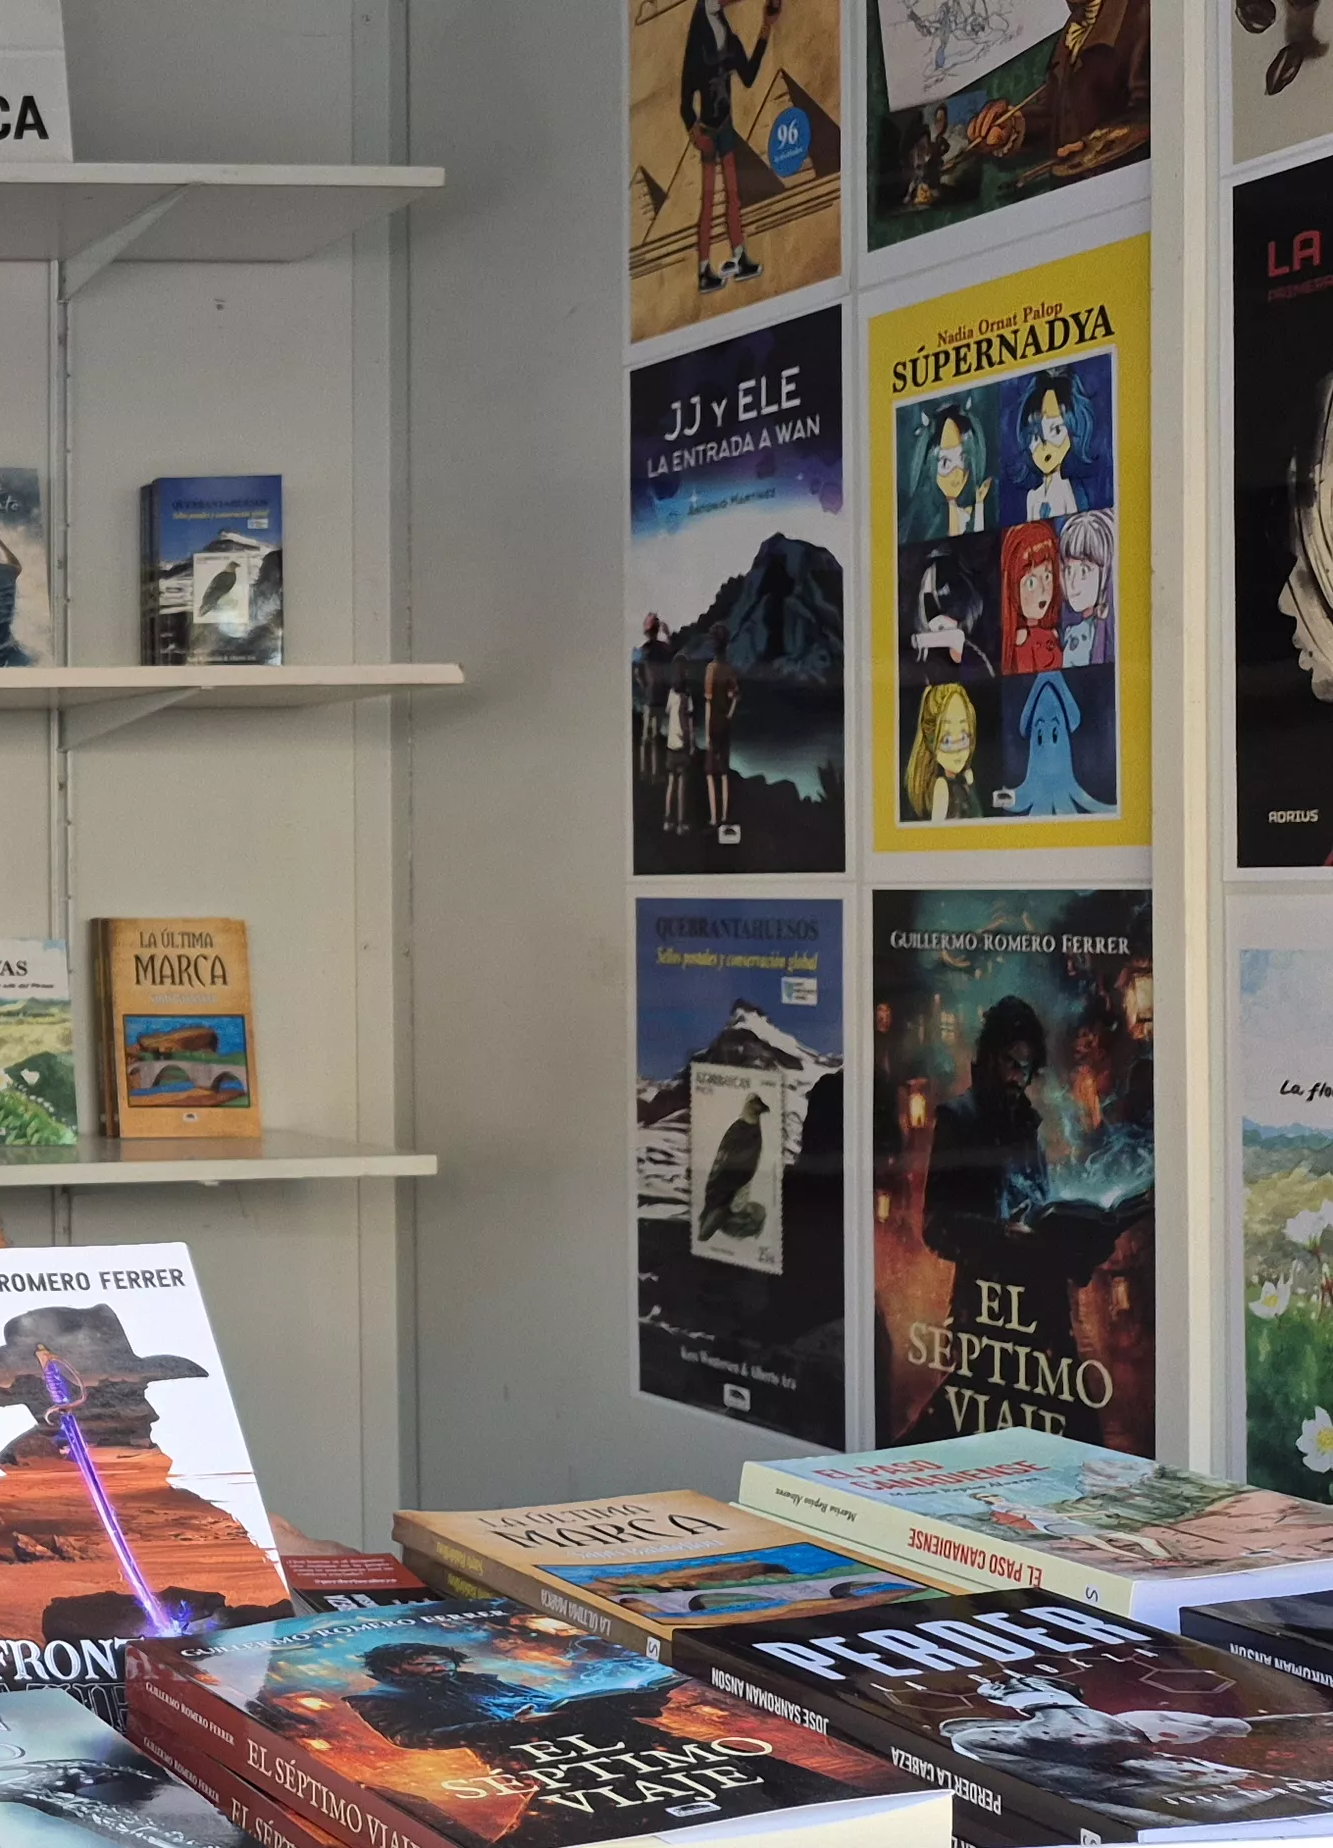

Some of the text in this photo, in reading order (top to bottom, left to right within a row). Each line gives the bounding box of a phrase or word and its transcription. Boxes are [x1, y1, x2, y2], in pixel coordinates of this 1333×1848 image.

[777, 119, 799, 150] 96
[1268, 230, 1321, 278] LA
[937, 301, 1063, 348] Nadia Ornat Palop
[892, 304, 1115, 394] SÚPERNADYA
[663, 365, 801, 441] JJ ELE
[646, 413, 821, 479] LA ENTRADA A WAN
[1268, 809, 1320, 823] ADRIUS
[139, 928, 214, 949] LA ÚLTIMA
[656, 917, 820, 941] QUEBRANTAHUESOS
[890, 929, 1131, 955] GUILLERMO ROMERO FERRER
[134, 953, 228, 988] MARCA
[1279, 1079, 1305, 1096] La
[99, 1267, 187, 1290] FERRER
[975, 1279, 1038, 1334] EL
[908, 1317, 1113, 1409] SÉPTIMO
[812, 1459, 945, 1480] EL PASO
[850, 1459, 1050, 1491] CANADIENSE
[477, 1503, 652, 1527] LA ÚLTIMA
[489, 1513, 730, 1549] MARCA
[907, 1527, 1043, 1588] EL PASO CANADIENSE
[180, 1609, 509, 1658] GUILLERMO ROMERO FERRER
[540, 1588, 611, 1637] LA ÚLTIMA MARCA
[751, 1605, 1153, 1682] PERDER
[145, 1681, 181, 1711] GUILLERMO
[181, 1701, 209, 1730] ROMERO
[209, 1720, 235, 1746] FERRER
[710, 1667, 830, 1736] JOSE SANROMAN ANSON
[441, 1737, 773, 1800] SÉPTIMO
[510, 1733, 626, 1763] EL
[246, 1737, 272, 1777] EL
[275, 1759, 363, 1834] SÉPTIMO
[538, 1766, 765, 1814] VIAJE
[890, 1746, 1002, 1816] PERDER LA CABEZA
